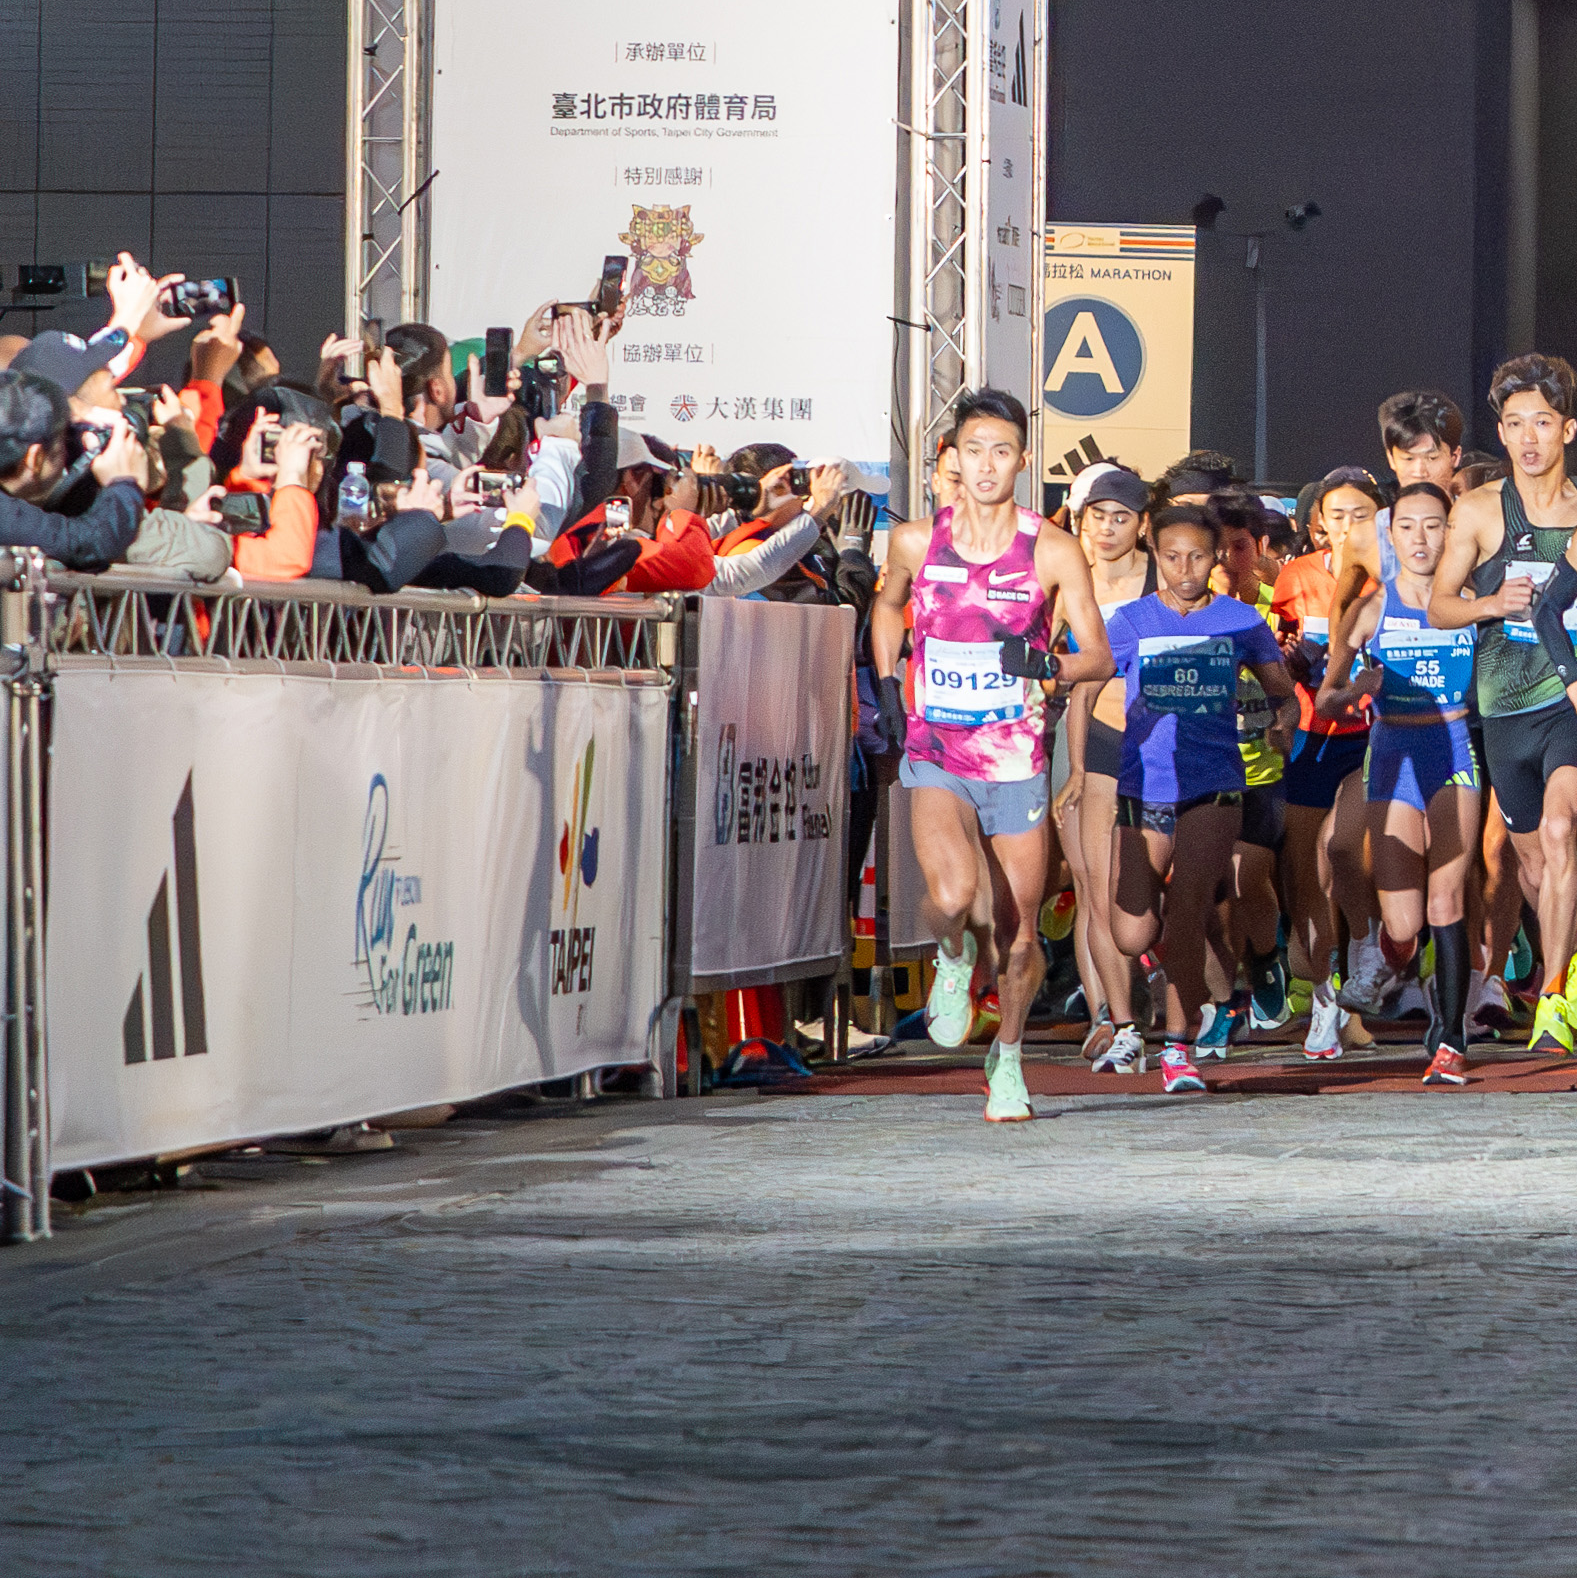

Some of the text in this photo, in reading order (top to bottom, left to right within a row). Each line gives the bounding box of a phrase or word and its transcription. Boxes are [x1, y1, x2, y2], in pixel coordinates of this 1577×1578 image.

[625, 42, 708, 62] 承辦單位
[552, 93, 778, 121] 臺北市政府體育局
[550, 126, 778, 139] Department of Sports, Taipei City Government
[623, 165, 704, 187] 特別感謝
[1090, 267, 1173, 282] MARATHON
[622, 343, 704, 364] 協辦單位
[1043, 311, 1126, 394] A
[705, 396, 814, 422] 大漢集團
[1456, 633, 1469, 646] A
[1450, 646, 1471, 658] JPN
[1174, 668, 1199, 685] 60
[1415, 660, 1441, 676] 55
[931, 668, 1019, 691] 09129
[401, 922, 456, 1017] Green
[549, 925, 596, 997] TAIPEI
